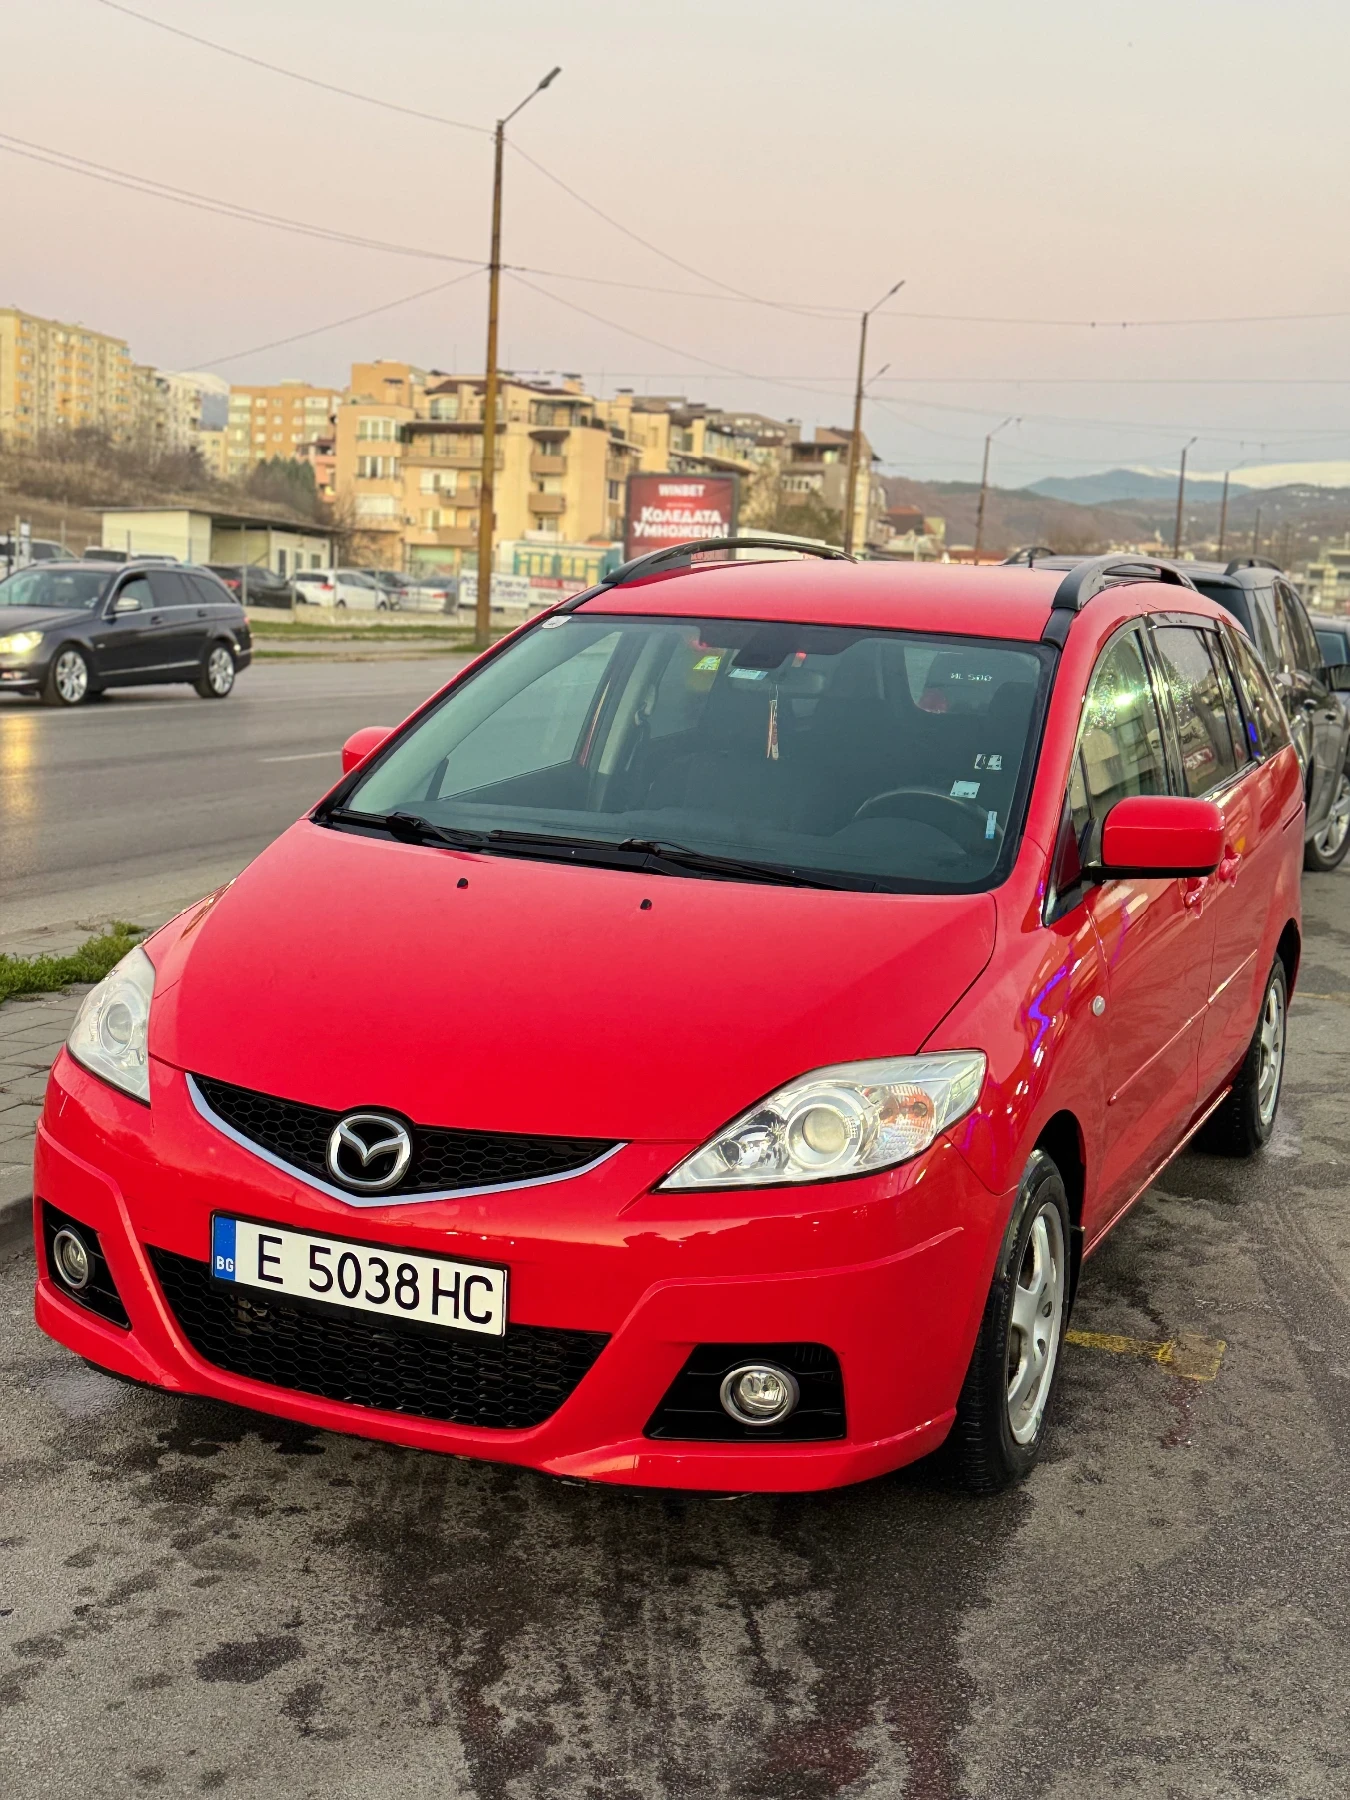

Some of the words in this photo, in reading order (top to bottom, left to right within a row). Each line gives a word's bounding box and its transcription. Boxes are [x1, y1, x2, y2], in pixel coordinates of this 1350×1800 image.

[658, 484, 706, 498] WINBET
[216, 1255, 234, 1272] BG
[257, 1233, 284, 1285] E
[308, 1243, 420, 1311] 5038
[431, 1267, 493, 1325] HC
